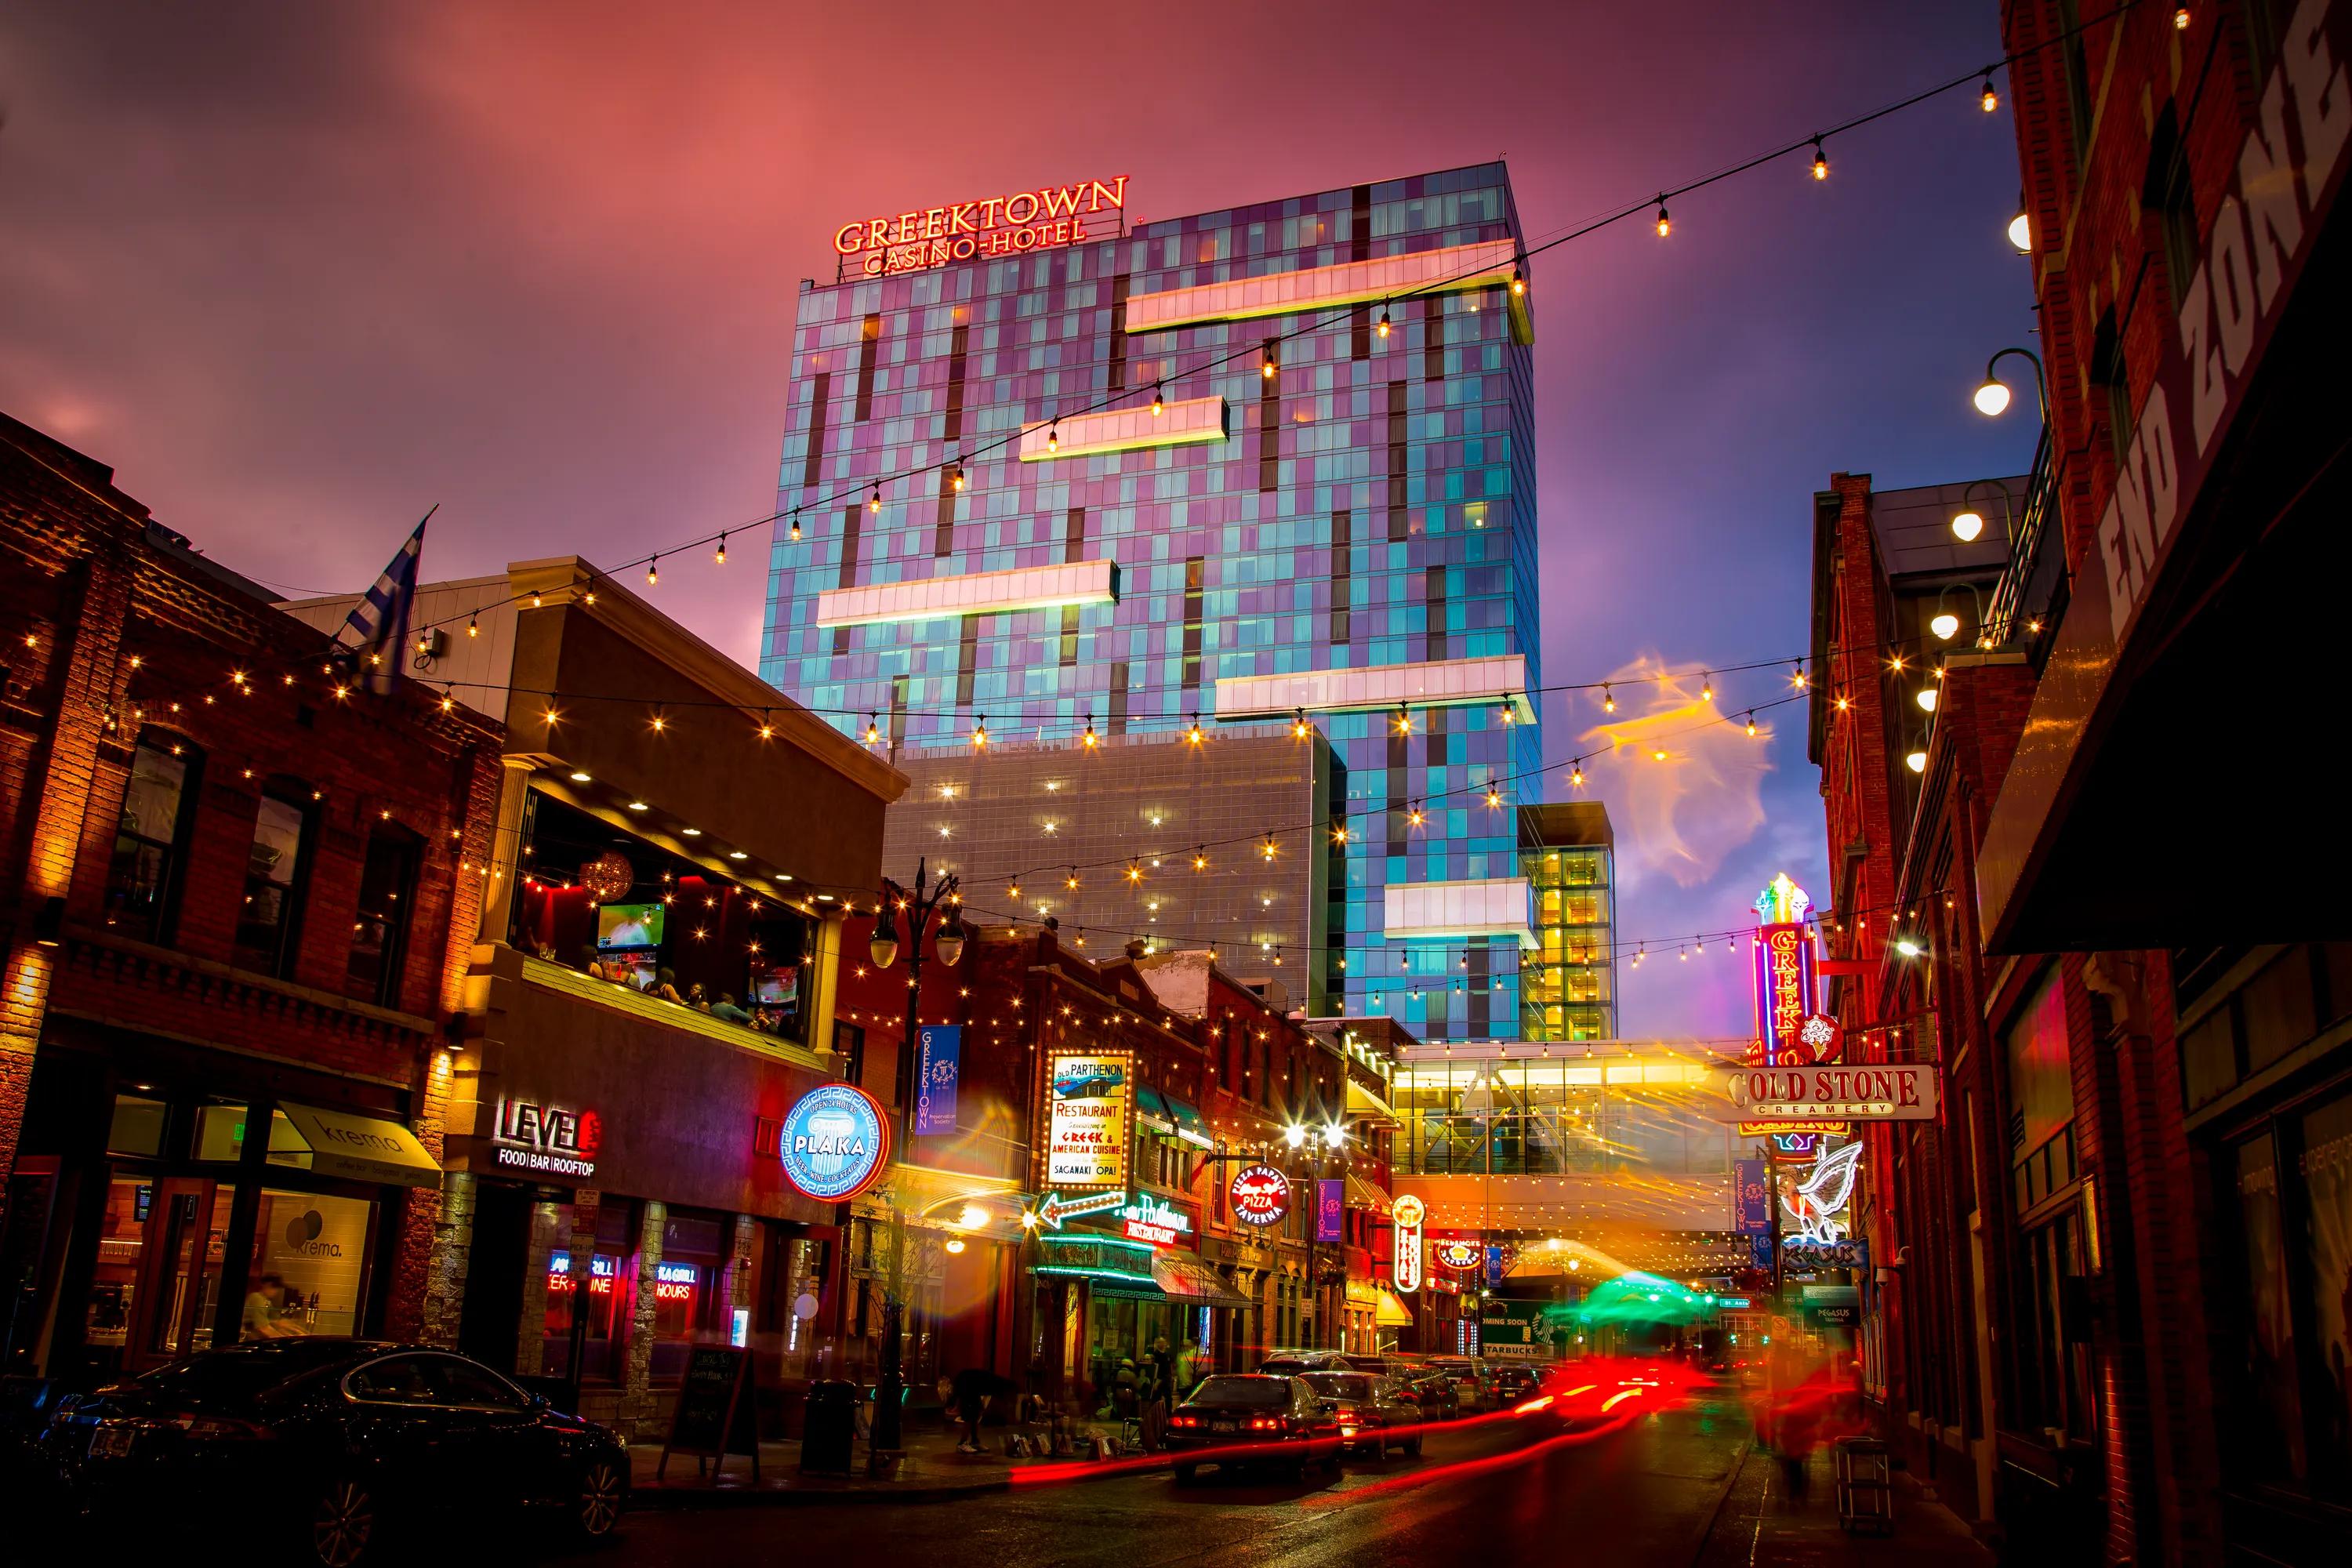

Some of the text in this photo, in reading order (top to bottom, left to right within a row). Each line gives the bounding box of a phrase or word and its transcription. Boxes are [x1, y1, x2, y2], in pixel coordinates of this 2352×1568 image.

[833, 175, 1130, 256] GREEKTOWN
[2098, 0, 2352, 644] END ZONE
[1771, 931, 1802, 1065] GREEKTO
[1071, 1064, 1123, 1076] PARTHENON
[919, 1032, 931, 1129] GREEKTOWN
[1726, 1070, 1920, 1108] COLD STONE
[810, 1100, 827, 1113] OPEN
[837, 1100, 858, 1115] HOURS
[1056, 1102, 1118, 1118] RESTAURANT
[1759, 1105, 1886, 1114] CREAMERY
[313, 1115, 405, 1152] krema
[500, 1099, 594, 1152] LEVEL
[793, 1135, 866, 1156] PLAKA
[1062, 1132, 1112, 1144] GREEK &
[1052, 1145, 1120, 1155] AMERICAN CUISINE
[810, 1171, 825, 1182] WINE
[827, 1158, 861, 1183] COCKTAILS
[1054, 1165, 1116, 1175] SAGANAKI OPA!
[1232, 1169, 1254, 1194] PIZZA
[1243, 1196, 1272, 1208] PIZZA
[1736, 1163, 1745, 1231] GREEKTOWN
[1235, 1203, 1283, 1223] TAVERNA
[1781, 1244, 1855, 1264] PEGASUS
[656, 1283, 690, 1299] HOURS
[1818, 1308, 1849, 1317] PEGASUS
